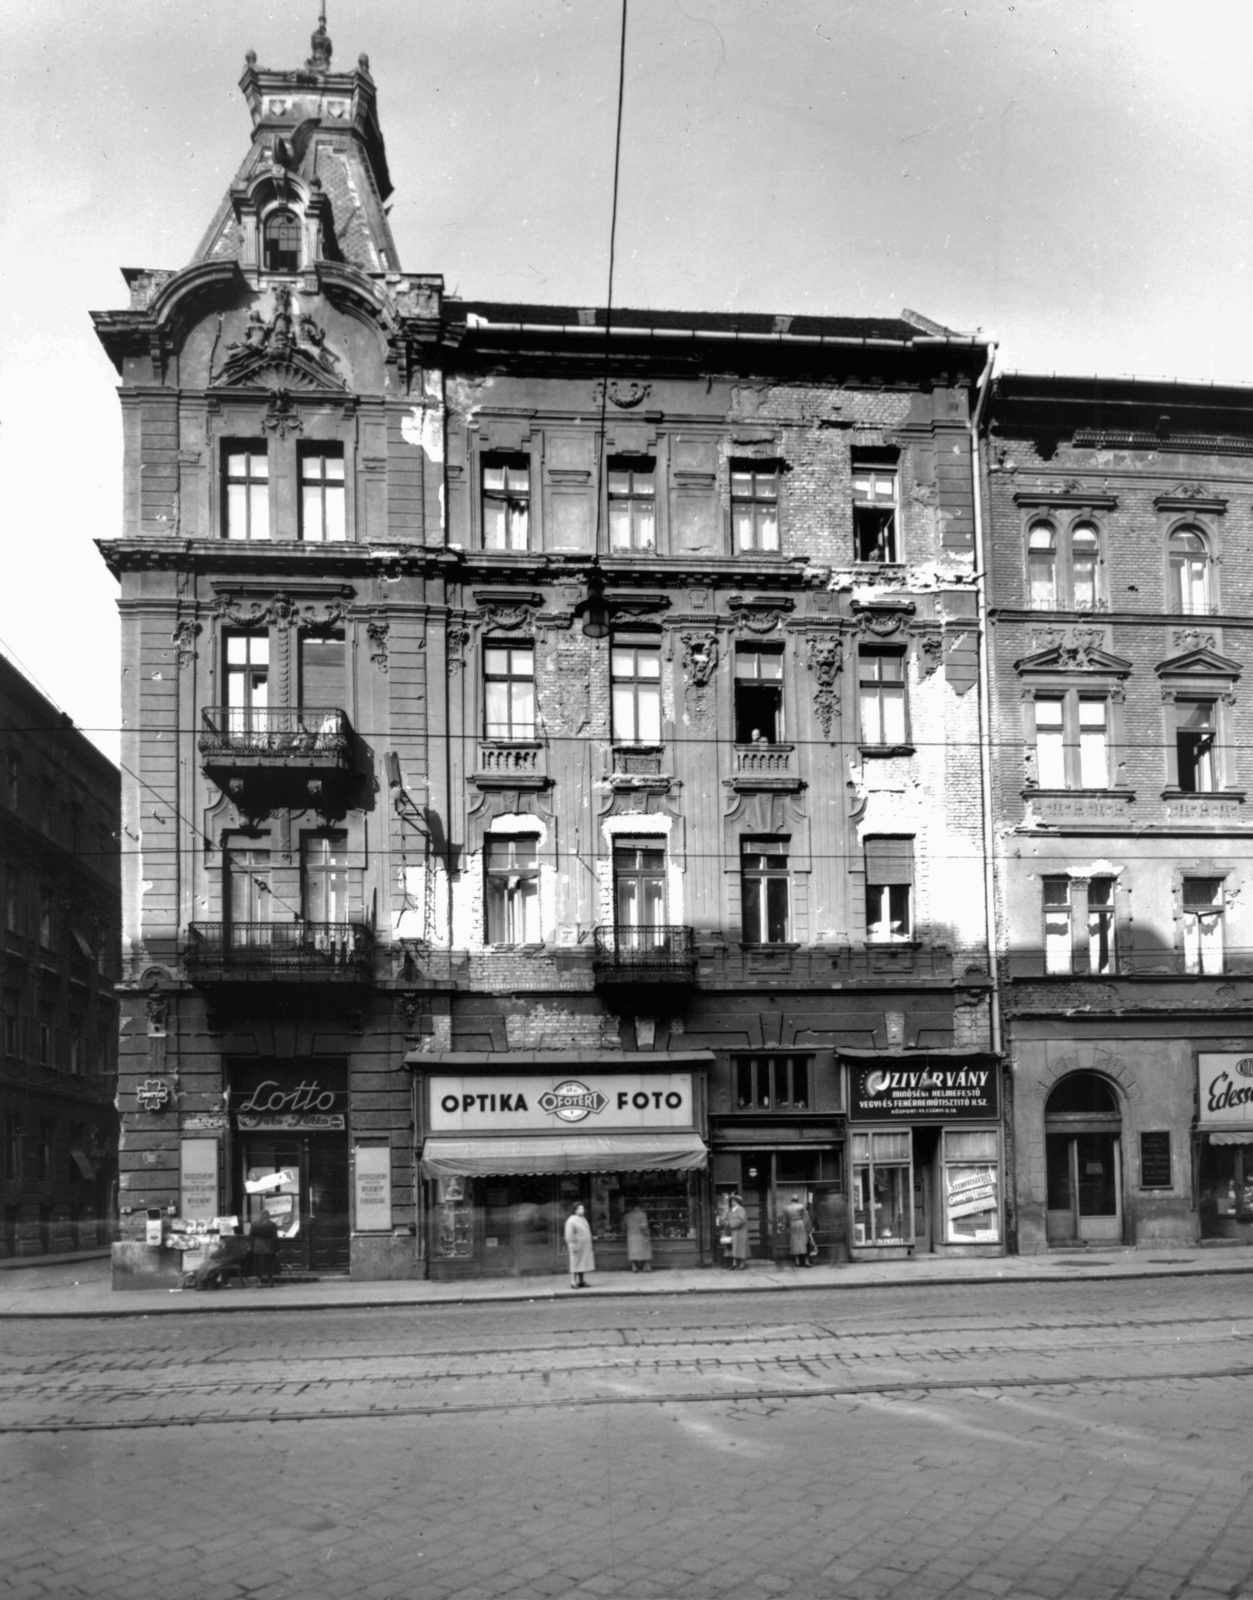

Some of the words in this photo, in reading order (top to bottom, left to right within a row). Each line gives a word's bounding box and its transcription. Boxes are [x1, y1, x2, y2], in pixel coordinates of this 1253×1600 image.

[240, 1080, 335, 1111] Lotto
[441, 1093, 528, 1112] OPTIKA
[541, 1092, 599, 1110] OFOTÉRT
[617, 1092, 682, 1110] FOTO
